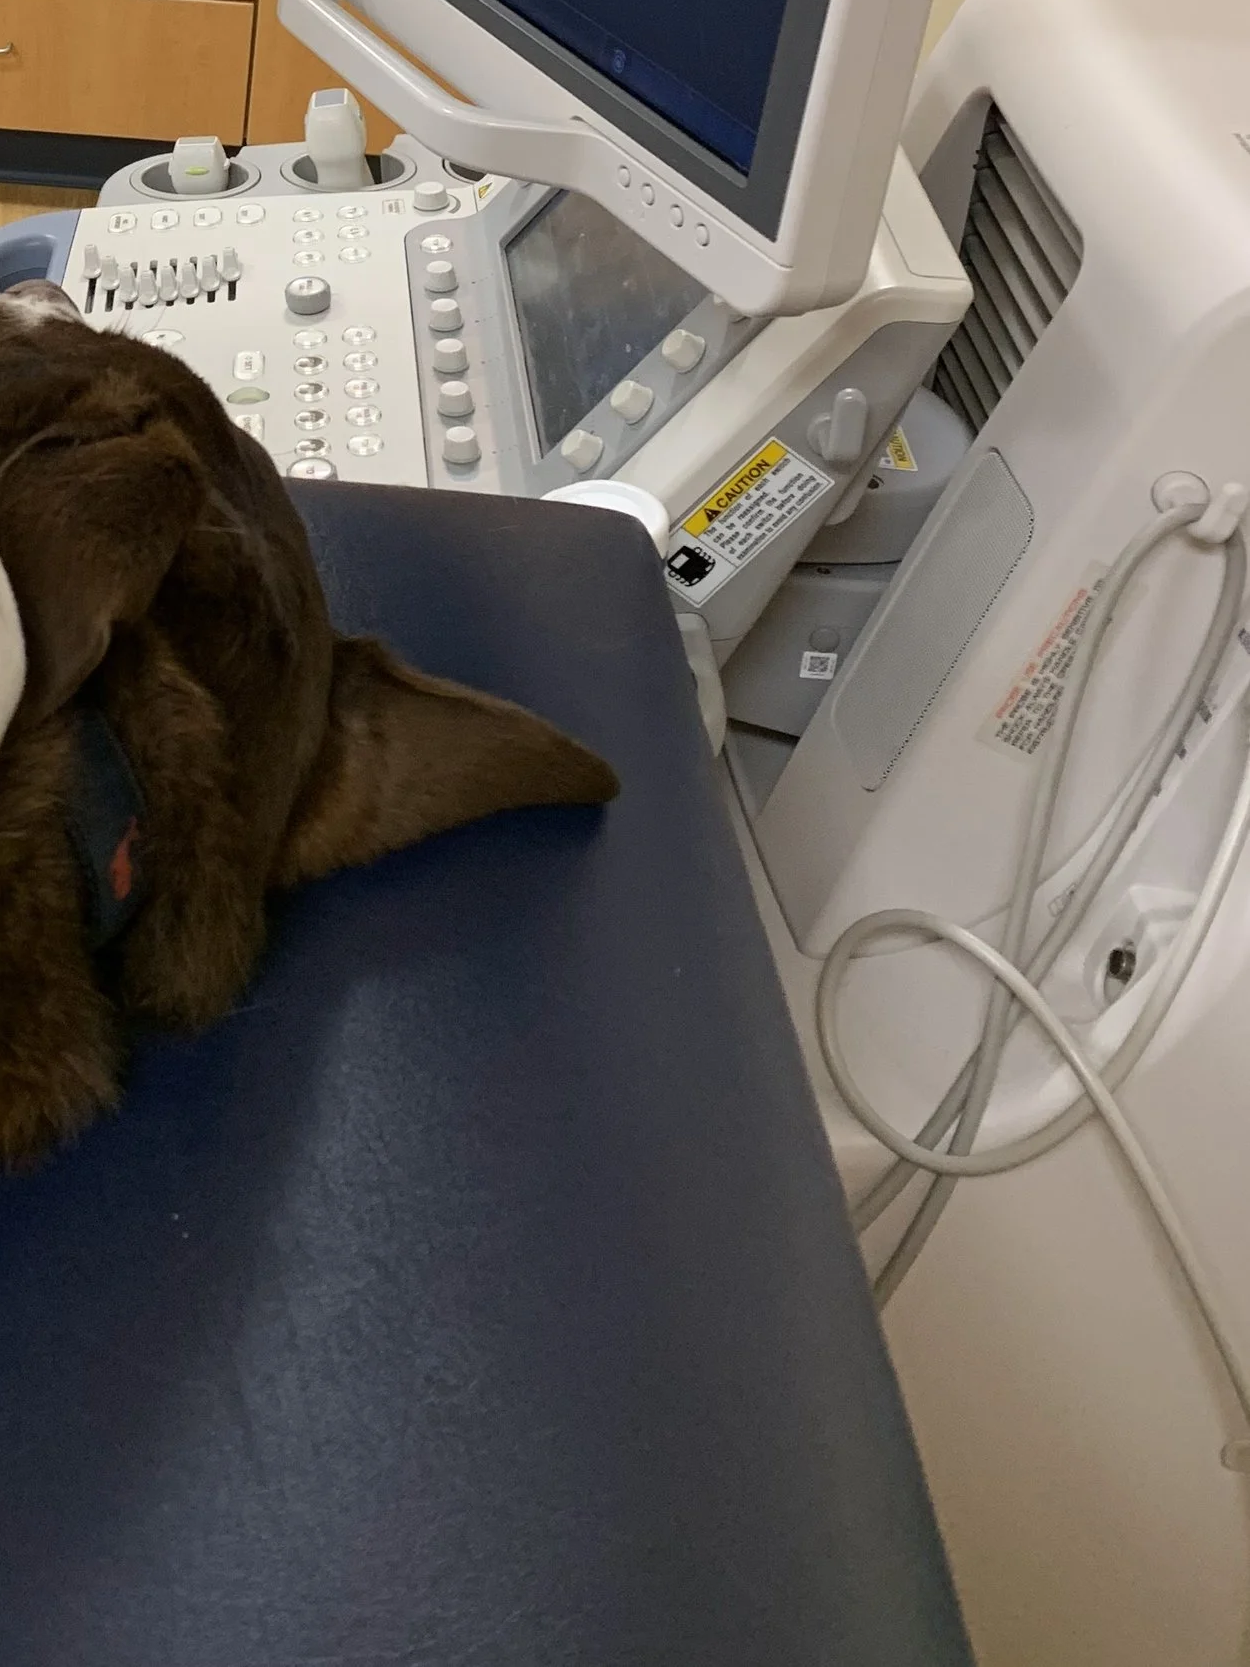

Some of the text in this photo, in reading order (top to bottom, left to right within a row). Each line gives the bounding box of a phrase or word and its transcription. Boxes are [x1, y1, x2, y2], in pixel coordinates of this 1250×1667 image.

[716, 459, 771, 508] CAUTION
[719, 472, 804, 549] Please confirm the function
[738, 532, 753, 546] each
[755, 513, 775, 530] switch
[775, 493, 795, 511] before
[797, 475, 817, 491] doing
